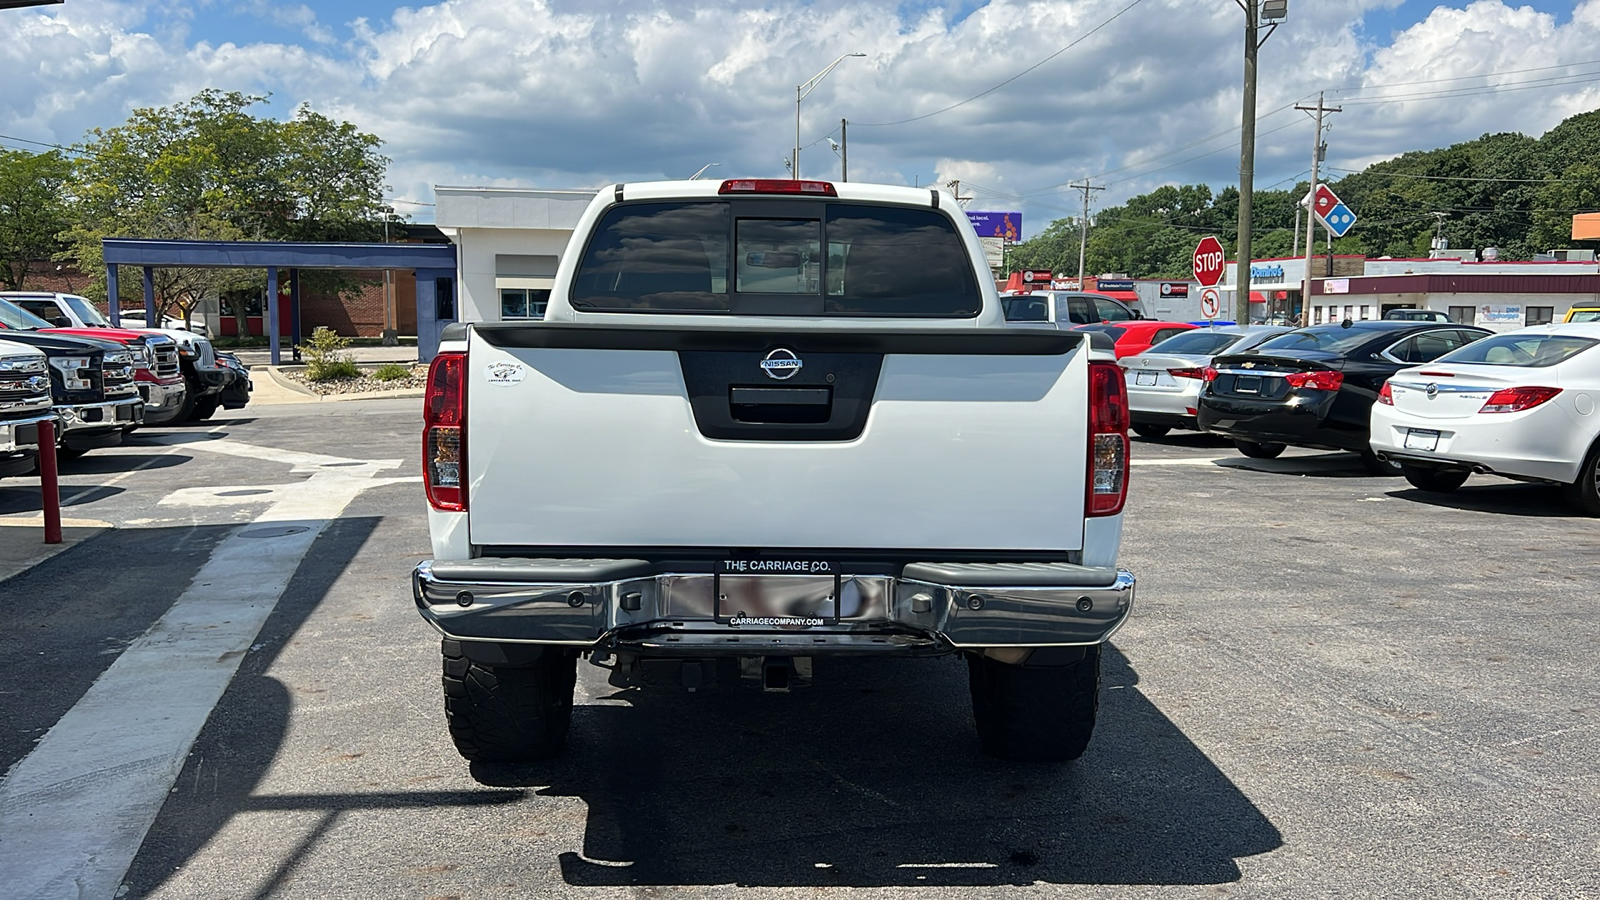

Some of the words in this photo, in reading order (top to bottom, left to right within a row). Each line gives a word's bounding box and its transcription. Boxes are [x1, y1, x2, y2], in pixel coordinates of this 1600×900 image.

[1195, 251, 1222, 273] STOP
[1251, 265, 1283, 278] Domino's
[724, 560, 748, 570] THE
[750, 560, 809, 571] CARRIAGE
[811, 561, 831, 571] CO.
[730, 617, 824, 626] CARRIAGECOMPANY.COM
